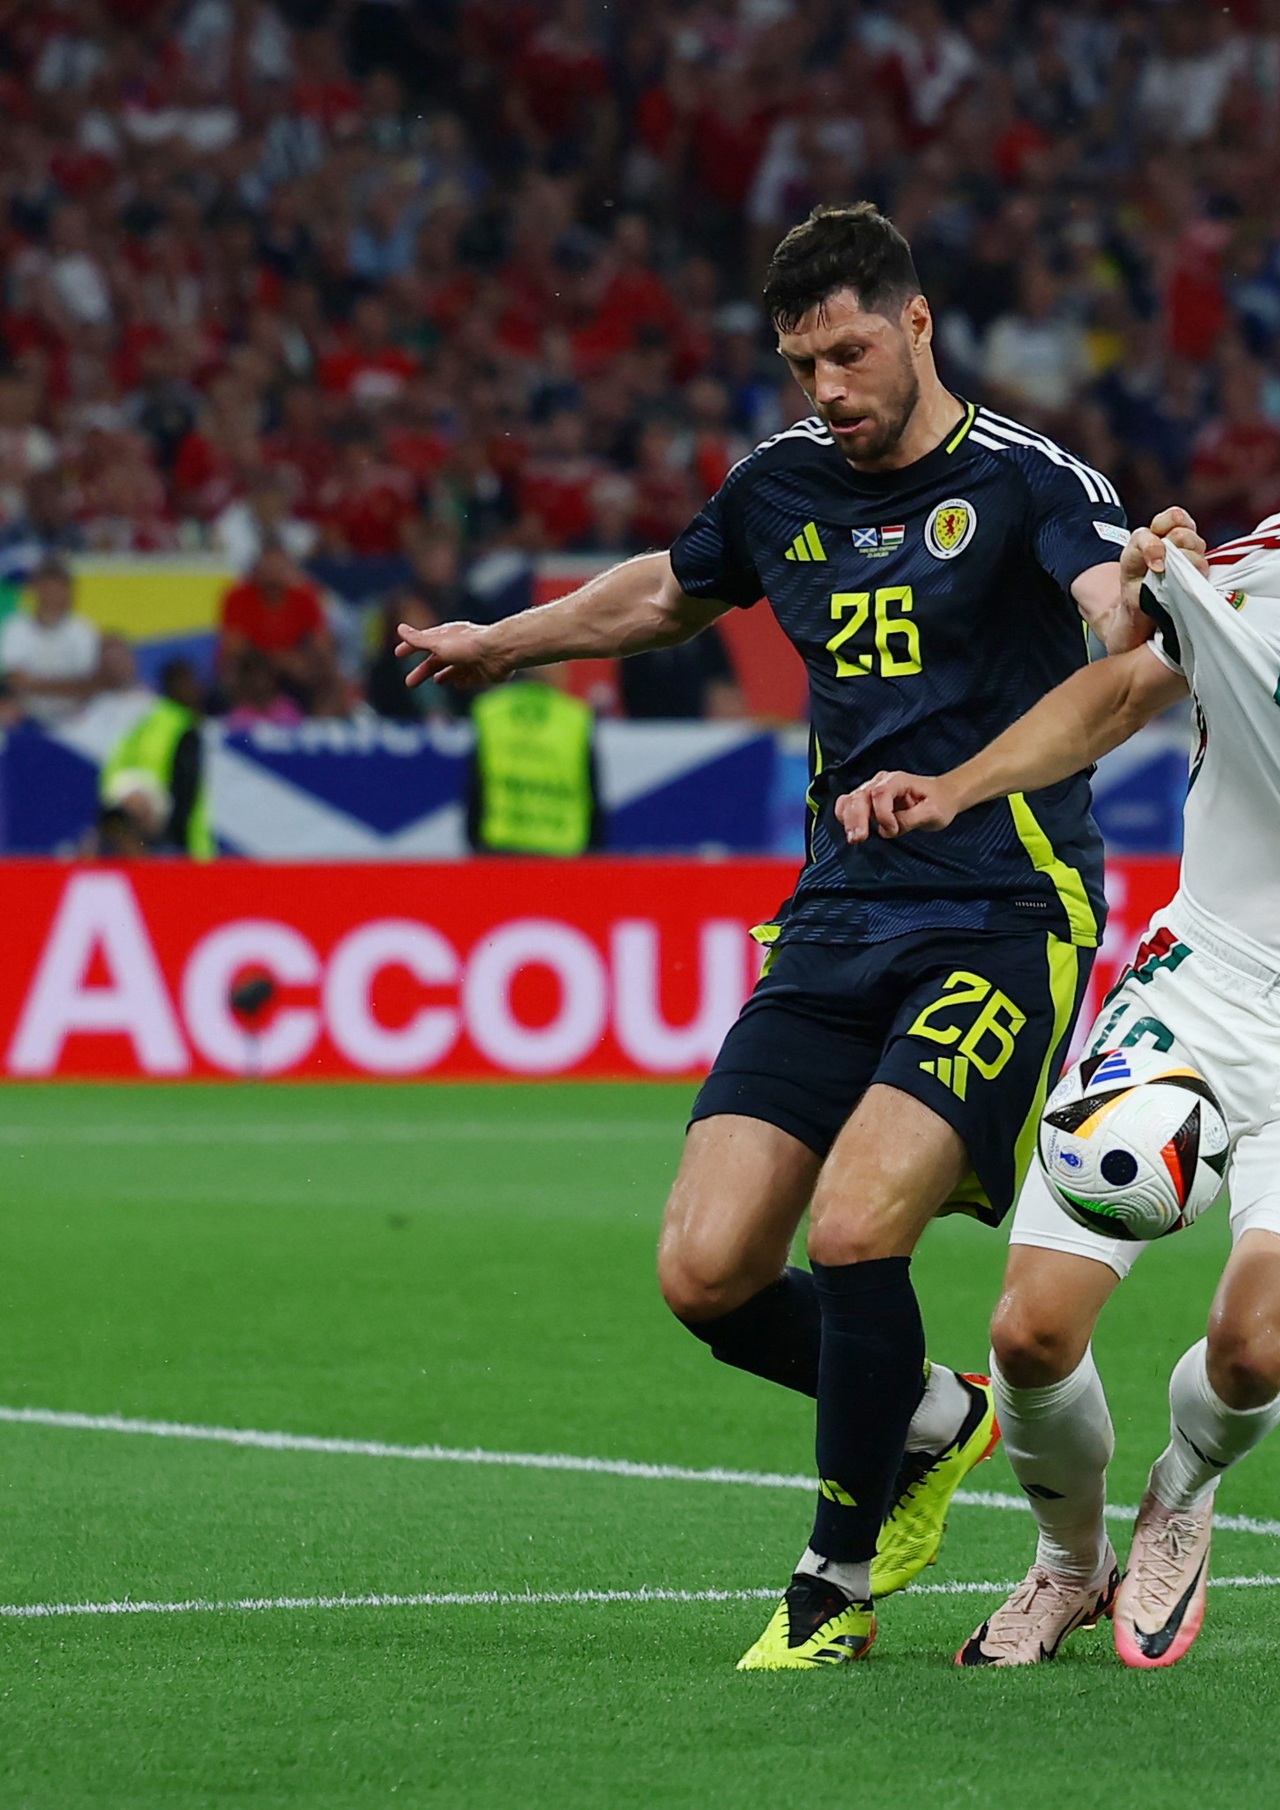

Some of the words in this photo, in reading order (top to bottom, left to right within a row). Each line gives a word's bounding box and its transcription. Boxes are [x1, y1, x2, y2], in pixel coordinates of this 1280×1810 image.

[826, 586, 922, 678] 26
[5, 868, 757, 1078] Accou
[907, 971, 1027, 1080] 26
